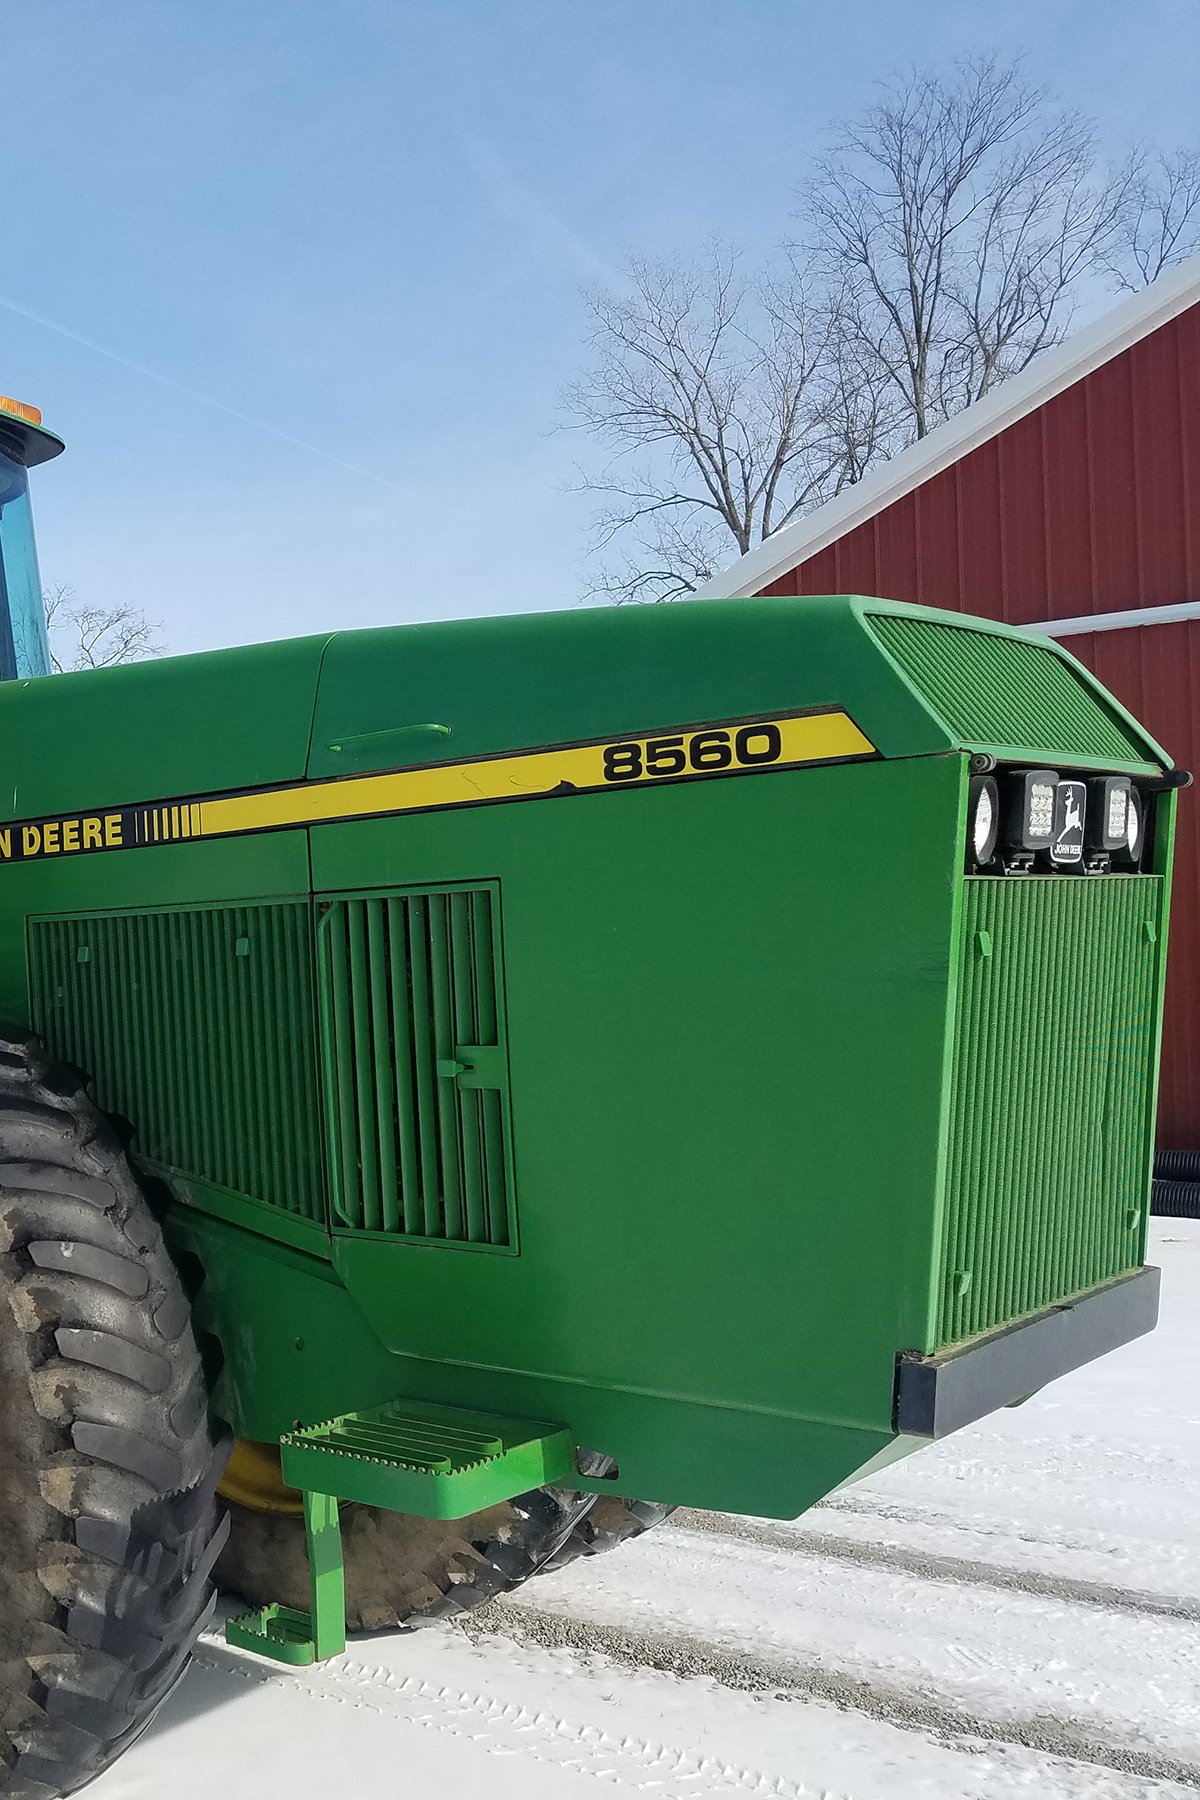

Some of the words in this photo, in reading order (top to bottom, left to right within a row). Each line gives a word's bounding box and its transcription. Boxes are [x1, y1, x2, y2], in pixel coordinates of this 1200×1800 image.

[603, 724, 781, 781] 8560
[22, 814, 123, 856] DEERE
[1054, 844, 1070, 855] JOHN
